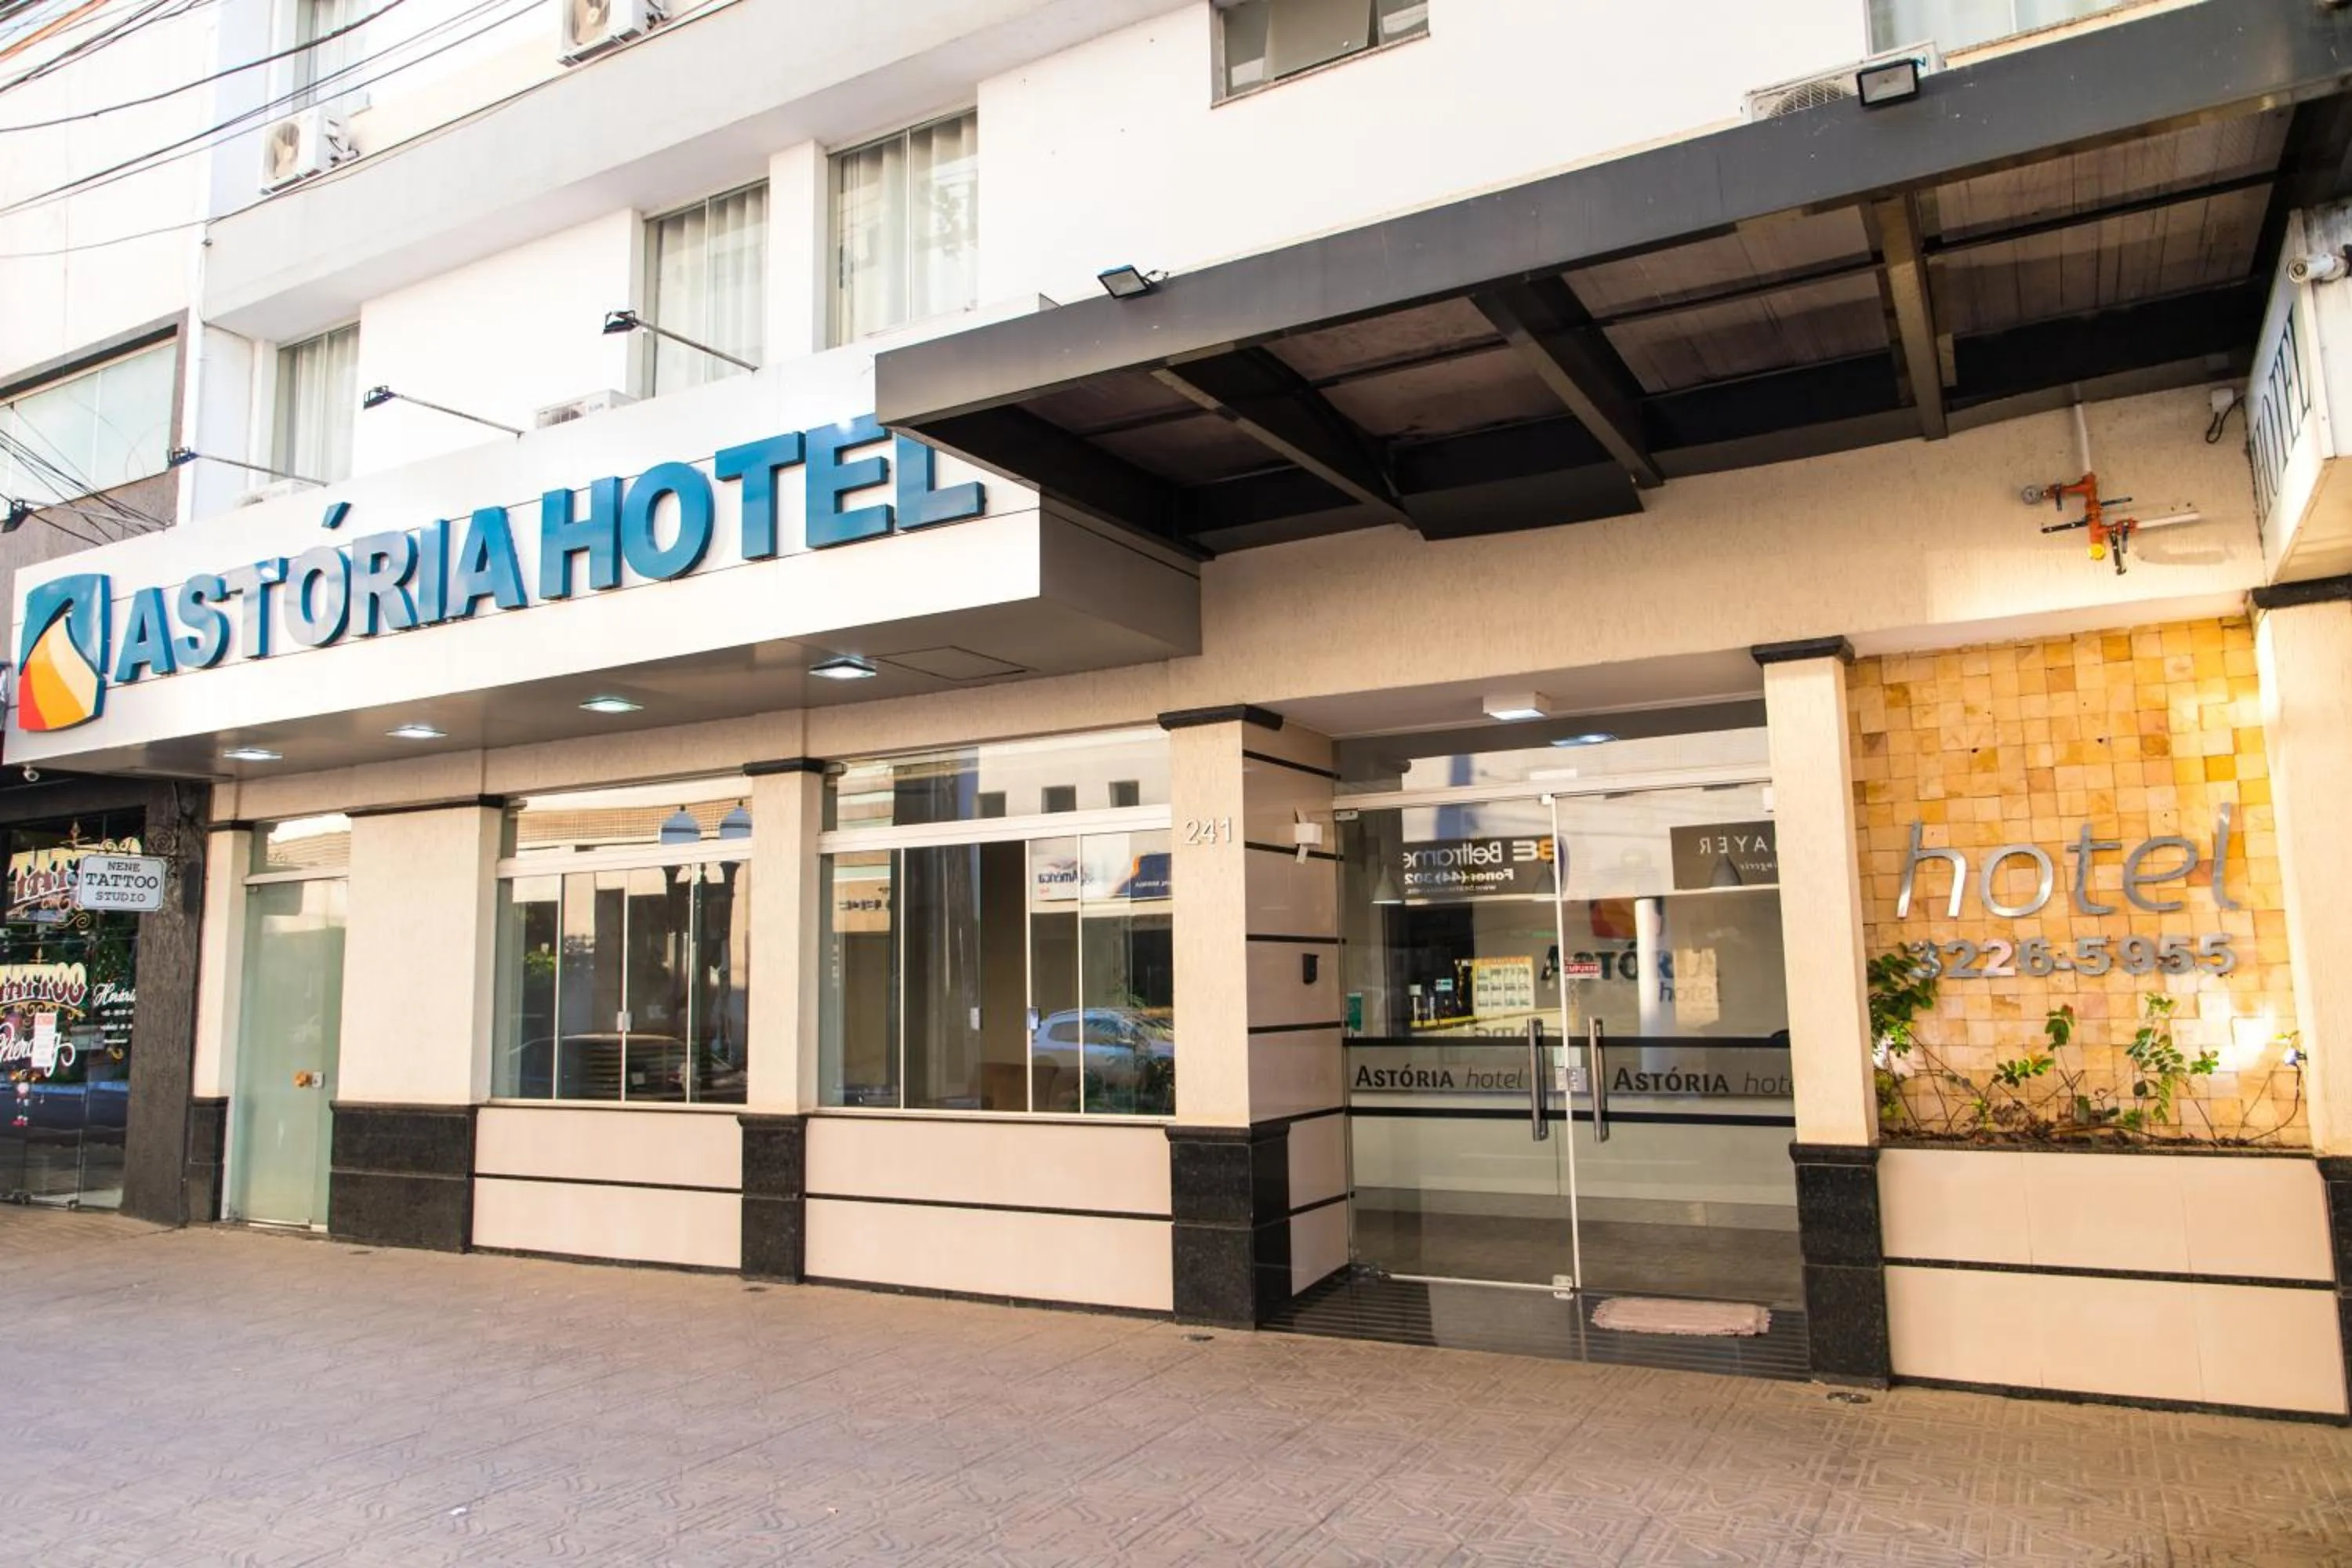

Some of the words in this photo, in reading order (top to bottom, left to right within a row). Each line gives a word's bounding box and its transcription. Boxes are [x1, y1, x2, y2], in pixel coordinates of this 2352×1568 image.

[2249, 303, 2312, 529] HOTEL
[114, 503, 528, 684] ASTÓRIA
[540, 416, 985, 601] HOTEL
[1185, 817, 1232, 846] 241
[107, 862, 141, 873] NENE
[1896, 801, 2242, 920] hotel
[85, 873, 158, 889] TATTOO
[95, 891, 147, 902] STUDIO
[1356, 1063, 1454, 1088] ASTÓRIA
[1465, 1067, 1523, 1089] hotel
[1613, 1067, 1730, 1092] ASTÓRIA
[1744, 1072, 1794, 1094] hot
